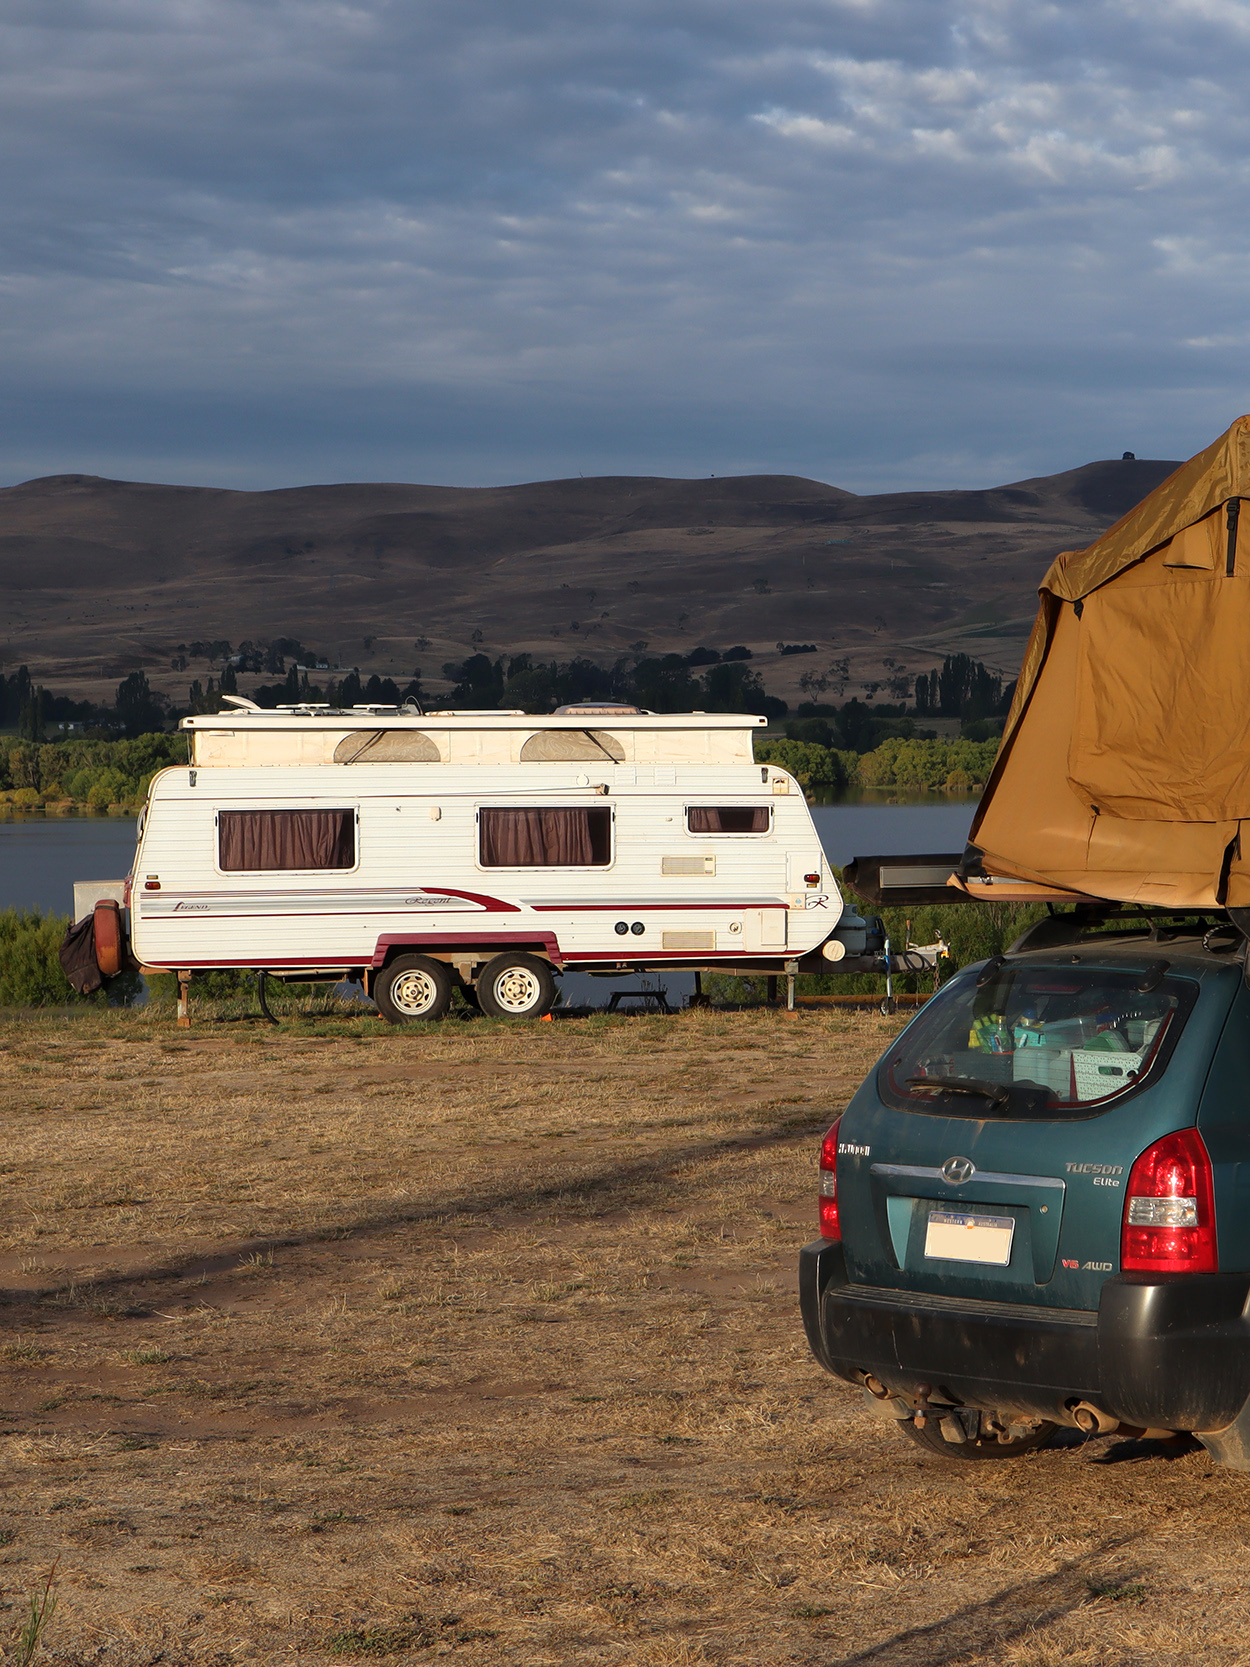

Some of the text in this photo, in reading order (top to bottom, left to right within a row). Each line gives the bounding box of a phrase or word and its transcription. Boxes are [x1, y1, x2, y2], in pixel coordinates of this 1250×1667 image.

[1065, 1162, 1124, 1175] TUCSON
[1093, 1177, 1120, 1187] Elite
[1061, 1258, 1113, 1271] V6 AWD
